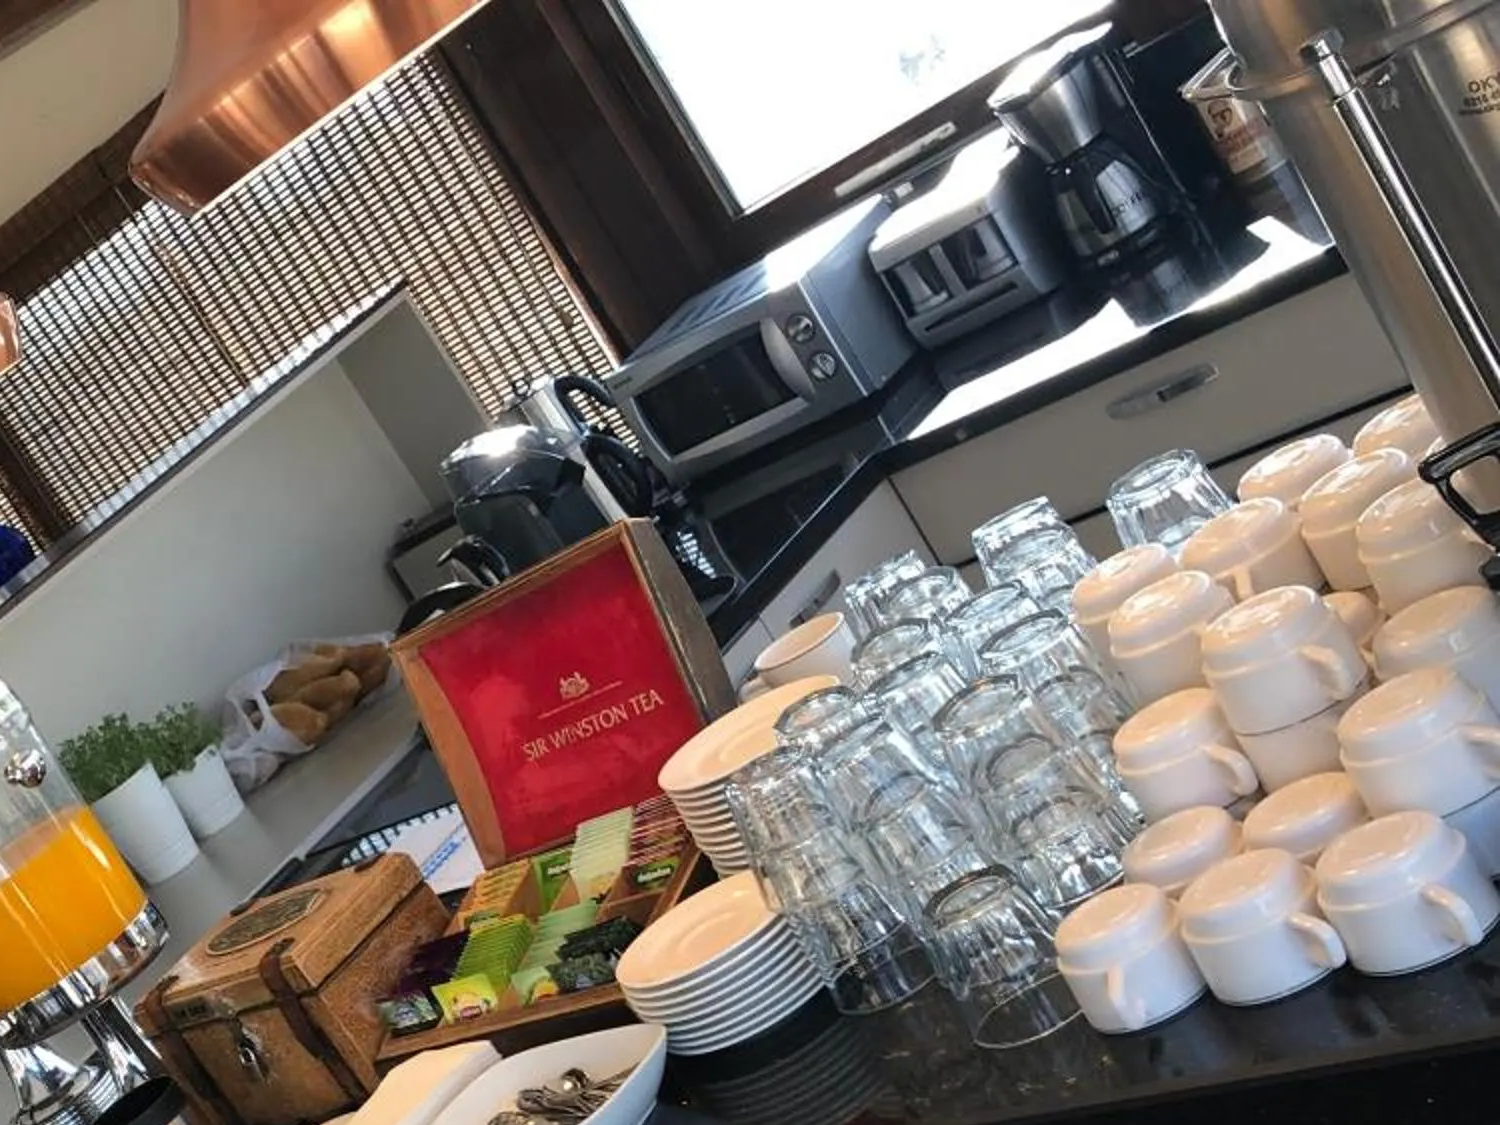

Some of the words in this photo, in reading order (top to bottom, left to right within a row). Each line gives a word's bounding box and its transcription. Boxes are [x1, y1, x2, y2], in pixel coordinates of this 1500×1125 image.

[521, 738, 549, 762] SIR
[549, 703, 629, 749] WINSTON
[628, 688, 664, 716] TEA
